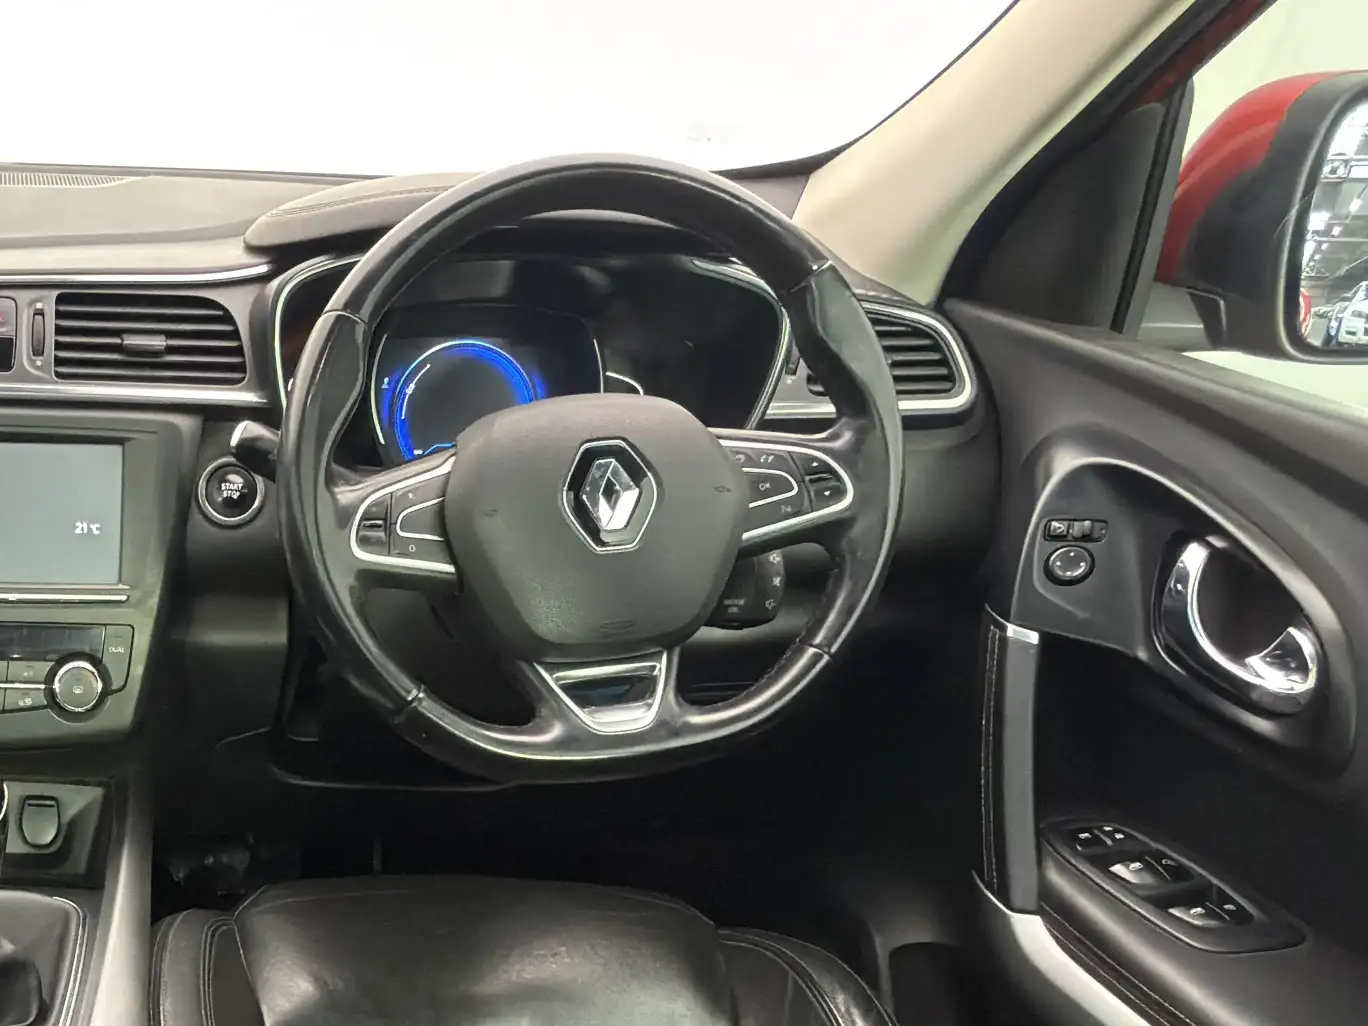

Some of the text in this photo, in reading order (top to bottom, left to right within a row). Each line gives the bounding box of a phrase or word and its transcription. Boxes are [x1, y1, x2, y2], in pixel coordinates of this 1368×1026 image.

[221, 482, 243, 490] START
[758, 482, 771, 491] OK
[223, 490, 240, 499] STOP
[74, 521, 88, 534] 21
